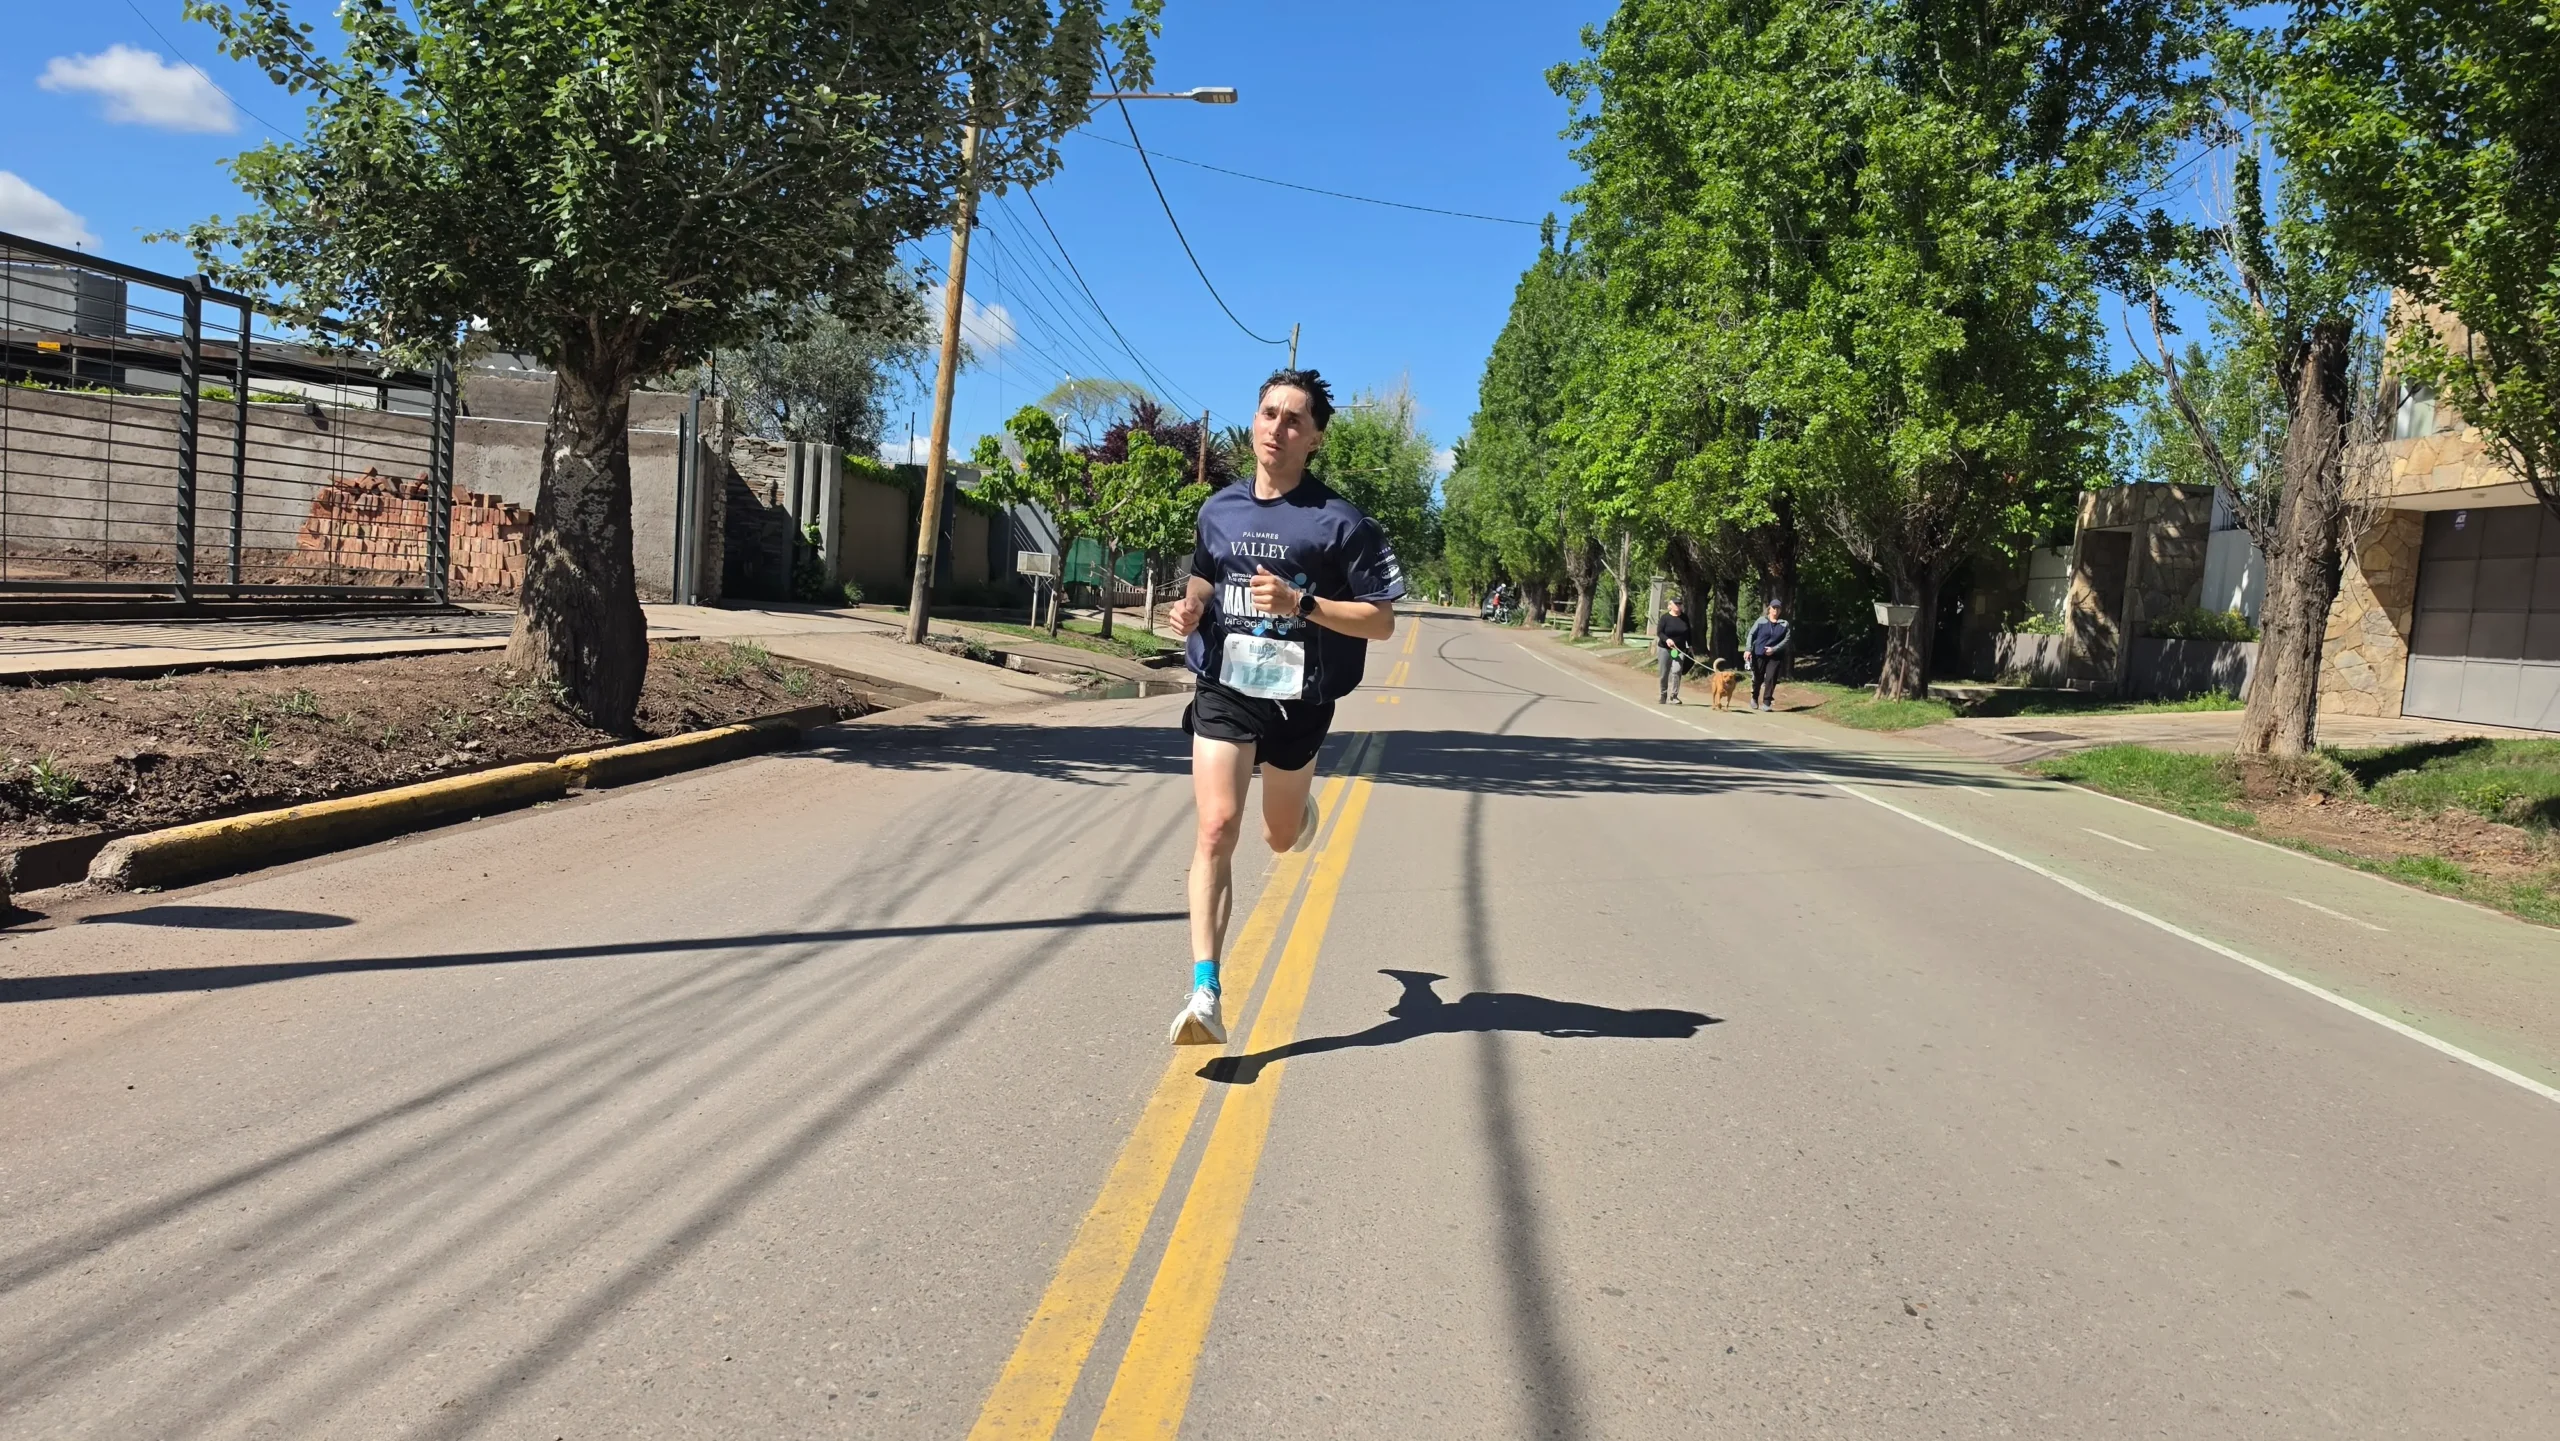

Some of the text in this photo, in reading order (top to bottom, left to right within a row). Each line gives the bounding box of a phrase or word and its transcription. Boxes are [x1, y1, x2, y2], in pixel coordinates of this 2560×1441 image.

[1242, 531, 1280, 540] PALMARES
[1230, 541, 1290, 560] VALLEY
[1275, 620, 1307, 630] familia
